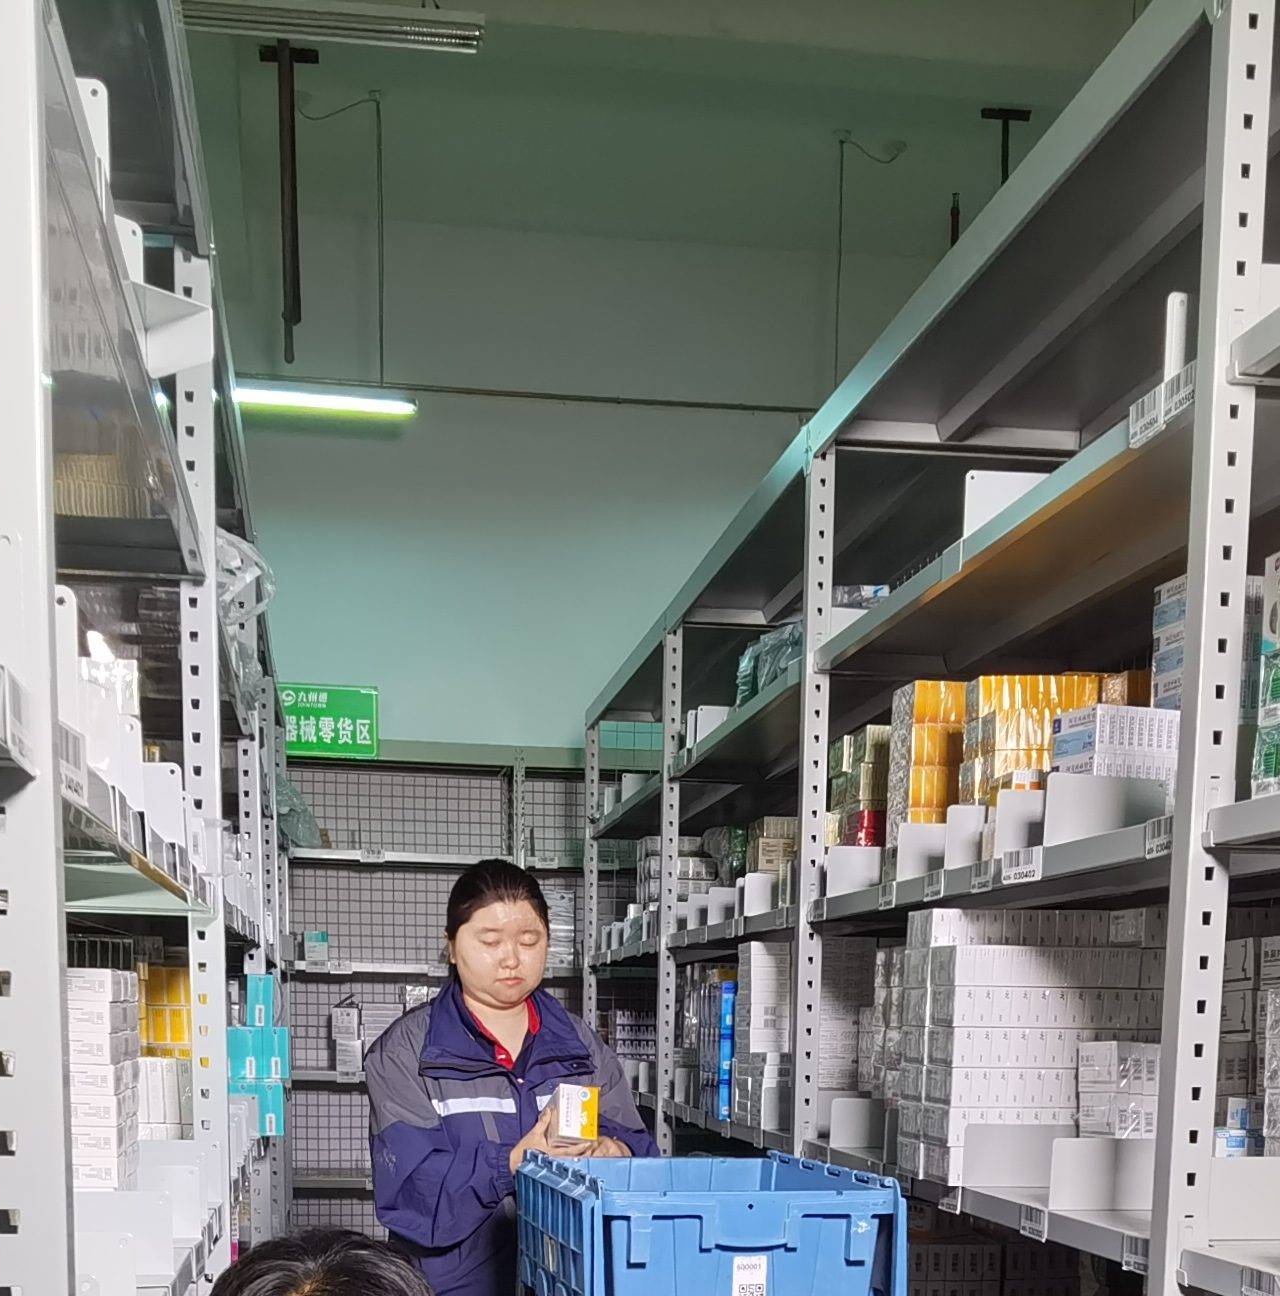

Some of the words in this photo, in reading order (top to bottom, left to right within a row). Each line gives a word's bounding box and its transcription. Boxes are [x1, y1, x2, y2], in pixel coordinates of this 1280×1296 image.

[298, 692, 328, 703] 九州通
[285, 715, 372, 744] 器械零货区
[1013, 870, 1036, 880] 030402
[736, 1263, 761, 1271] 600001
